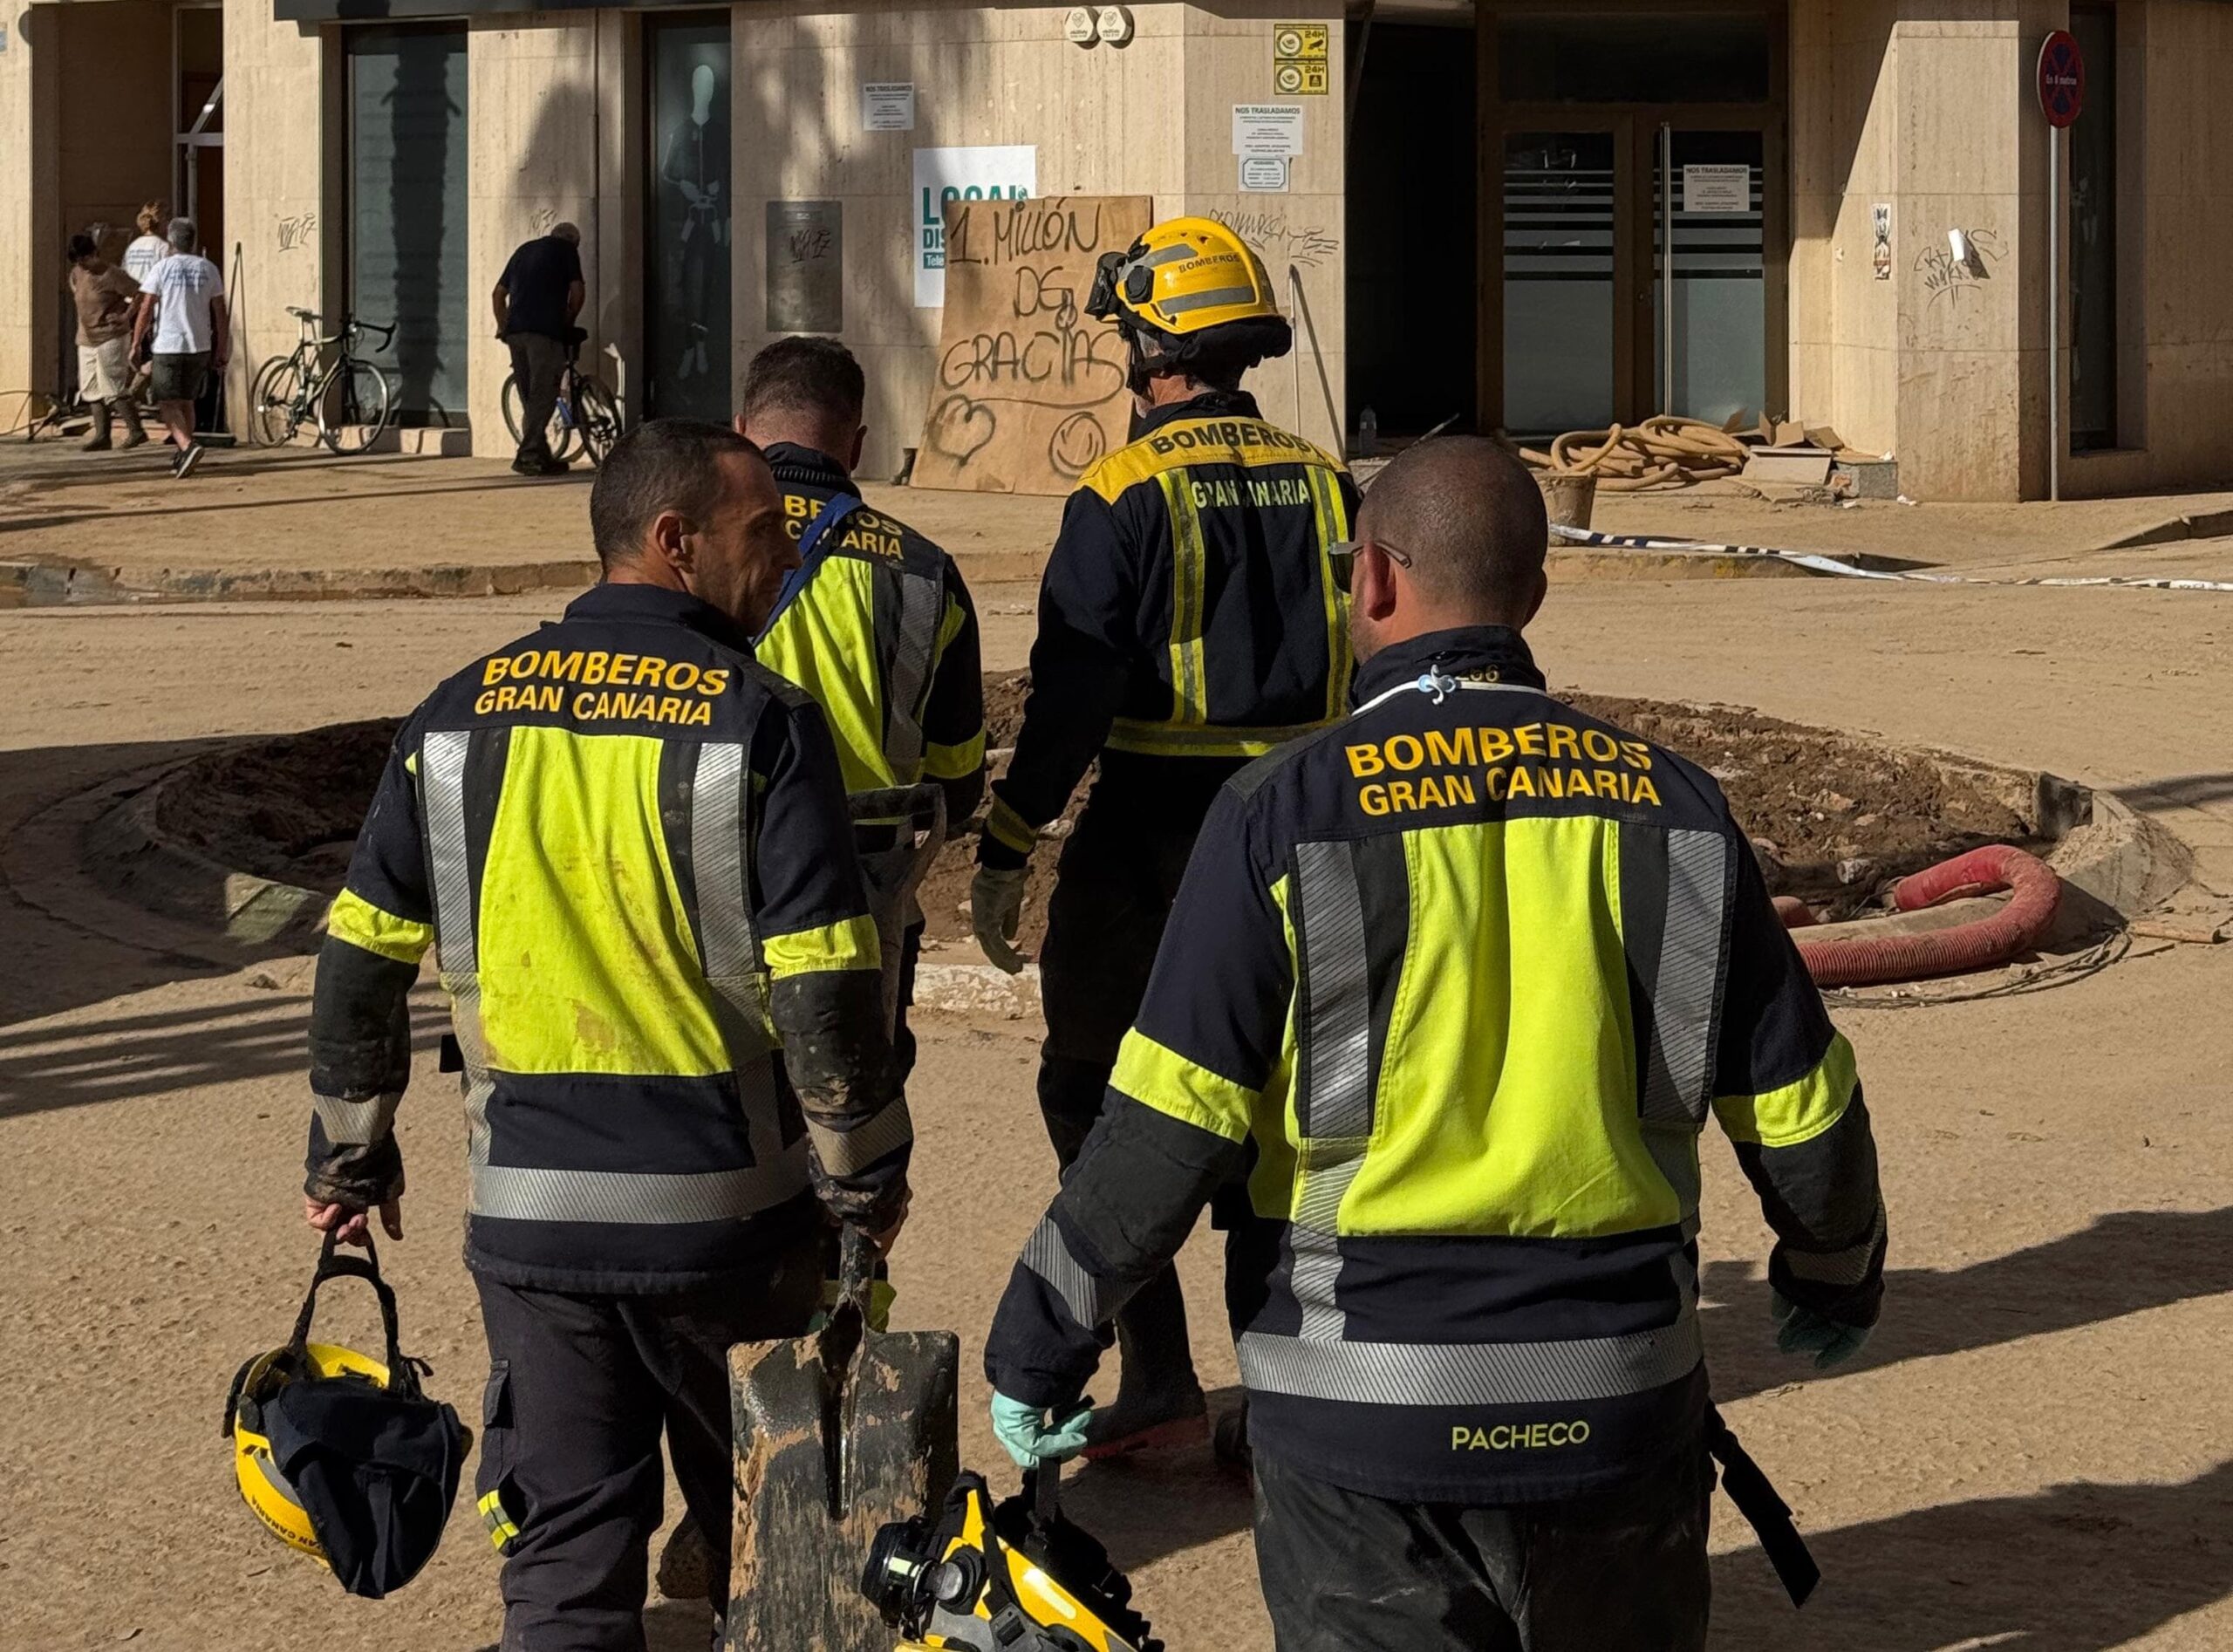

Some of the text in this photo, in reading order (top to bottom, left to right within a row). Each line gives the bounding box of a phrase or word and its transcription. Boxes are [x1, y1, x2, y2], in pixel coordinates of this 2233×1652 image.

[1178, 254, 1240, 273] BOMBEROS
[1151, 422, 1311, 454] BOMBEROS
[784, 519, 905, 561] CARIA
[482, 650, 730, 695] BOMBEROS
[474, 684, 712, 726] GRAN CANARIA
[1344, 722, 1652, 778] BOMBEROS
[1359, 766, 1662, 816] GRAN CANARIA
[1451, 1420, 1590, 1451] PACHECO
